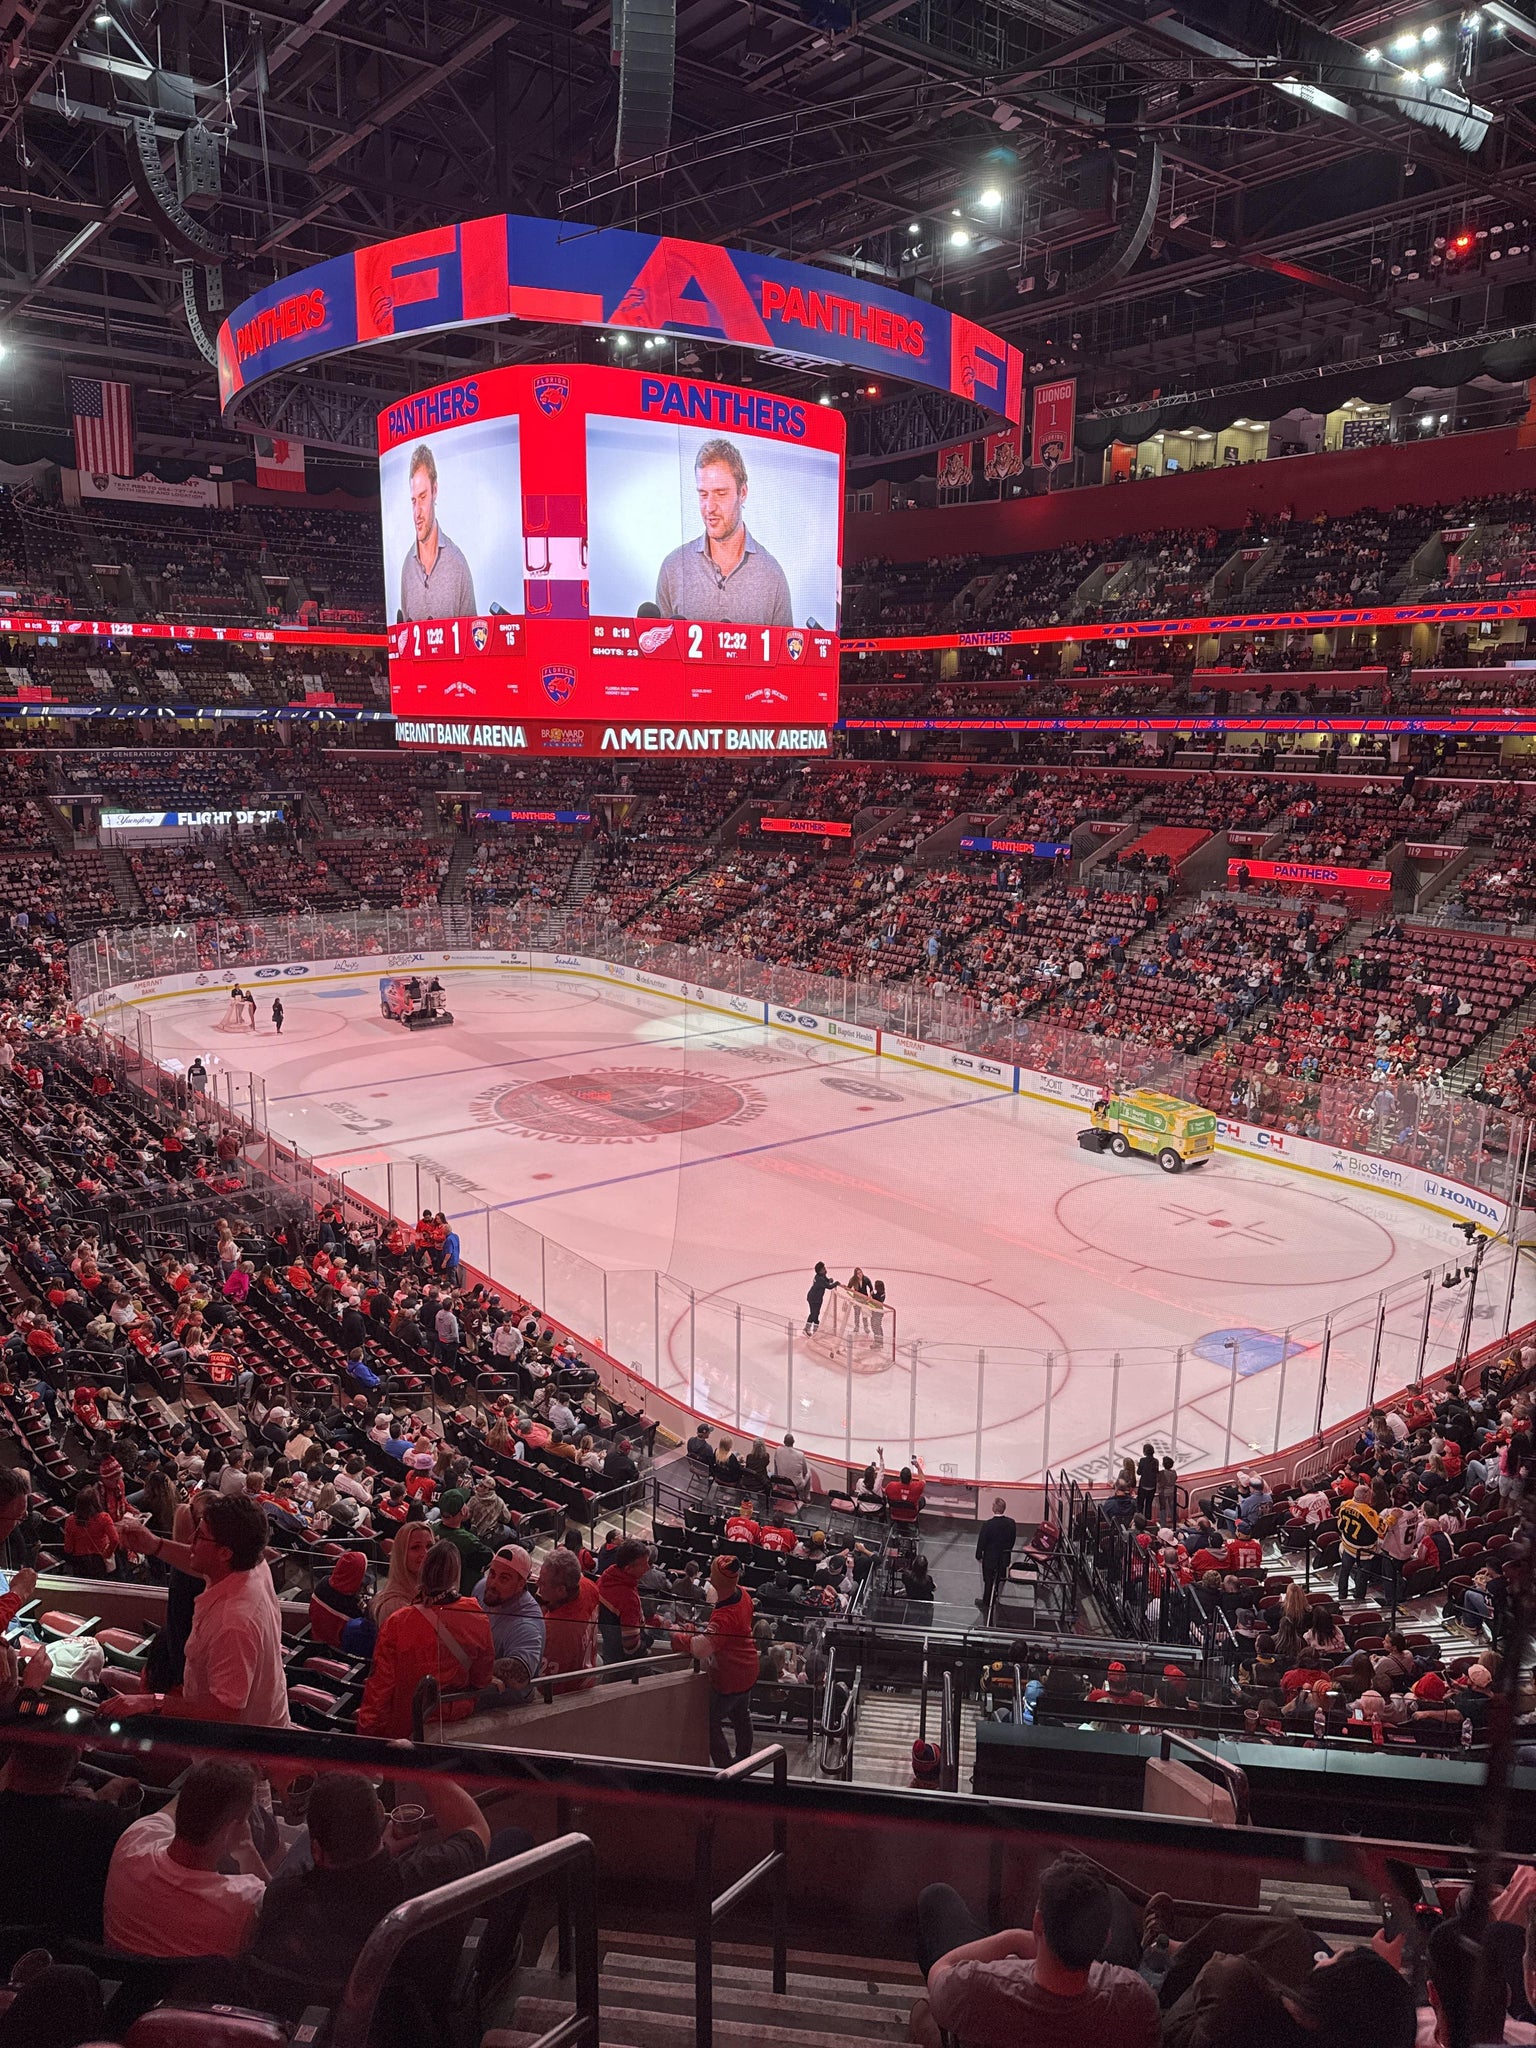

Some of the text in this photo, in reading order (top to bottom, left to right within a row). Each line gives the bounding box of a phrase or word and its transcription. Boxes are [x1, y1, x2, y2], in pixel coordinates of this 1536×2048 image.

[235, 288, 326, 364] PANTHERS
[761, 280, 925, 357] PANTHERS
[1038, 385, 1071, 405] LUONGO
[389, 381, 480, 442] PANTHERS
[641, 379, 806, 438] PANTHERS
[1050, 404, 1057, 426] 1
[92, 623, 98, 634] 2
[110, 624, 133, 635] 12:32
[413, 621, 520, 656] 2 12:32 1 SHOTS
[506, 632, 516, 646] 15
[688, 624, 703, 658] 2
[718, 632, 747, 650] 12:32
[760, 629, 770, 662] 1
[958, 632, 1012, 646] PANTHERS
[592, 648, 624, 656] SHOTS:
[820, 646, 827, 658] 15
[438, 724, 470, 746] BANK
[472, 724, 526, 748] ARENA
[600, 728, 828, 750] AMERANT BANK ARENA
[512, 812, 556, 821] PANTHERS
[790, 822, 826, 832] PANTHERS
[1229, 834, 1240, 843] 118
[992, 840, 1035, 854] PANTHERS
[1408, 847, 1420, 856] 119
[1274, 866, 1338, 882] PANTHERS
[134, 979, 163, 990] AMERANT
[838, 1026, 855, 1038] Baptist
[856, 1032, 873, 1042] Health
[896, 1038, 925, 1052] AMERANT
[904, 1049, 917, 1058] BANK
[590, 1066, 730, 1080] AMERANT
[1216, 1122, 1240, 1138] CH
[1250, 1141, 1267, 1150] Cooper
[1257, 1132, 1284, 1150] CH
[1349, 1156, 1402, 1182] BioStem
[1440, 1187, 1498, 1222] HONDA
[1342, 1514, 1362, 1540] 77
